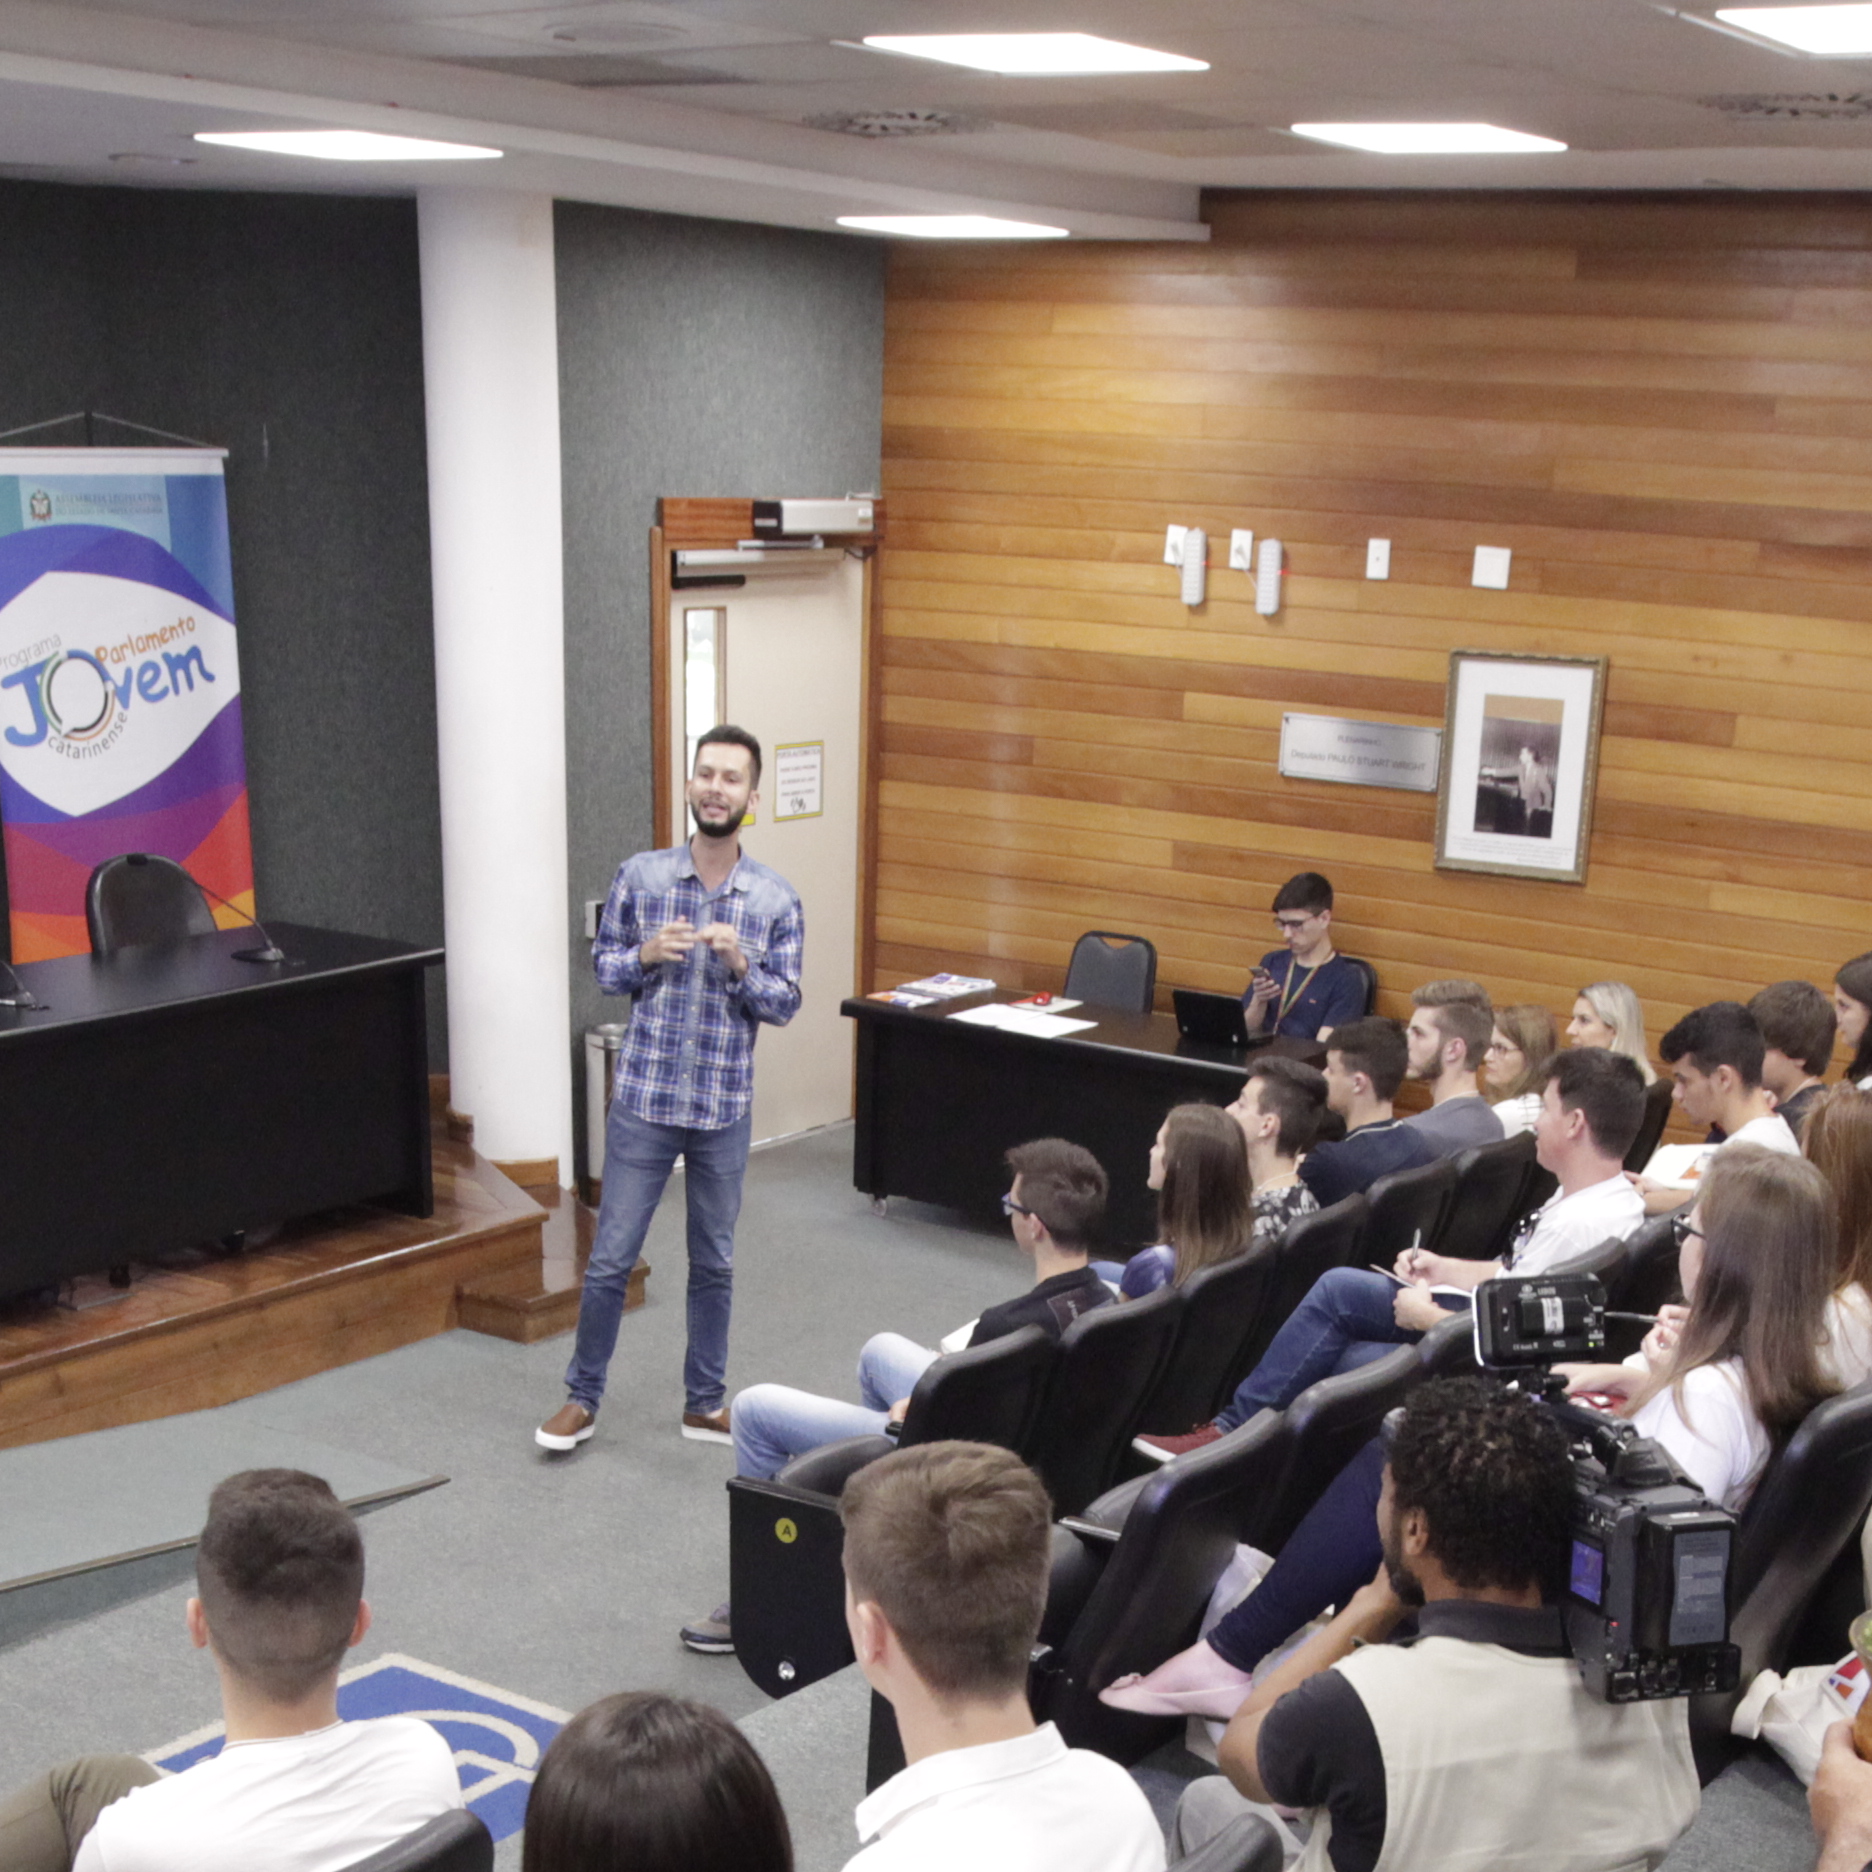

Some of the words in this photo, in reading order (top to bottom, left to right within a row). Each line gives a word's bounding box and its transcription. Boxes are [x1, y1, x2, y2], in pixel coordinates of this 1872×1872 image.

[1291, 749, 1325, 761] Deputado
[1328, 754, 1355, 764] PAULO
[1356, 756, 1390, 768] STUART
